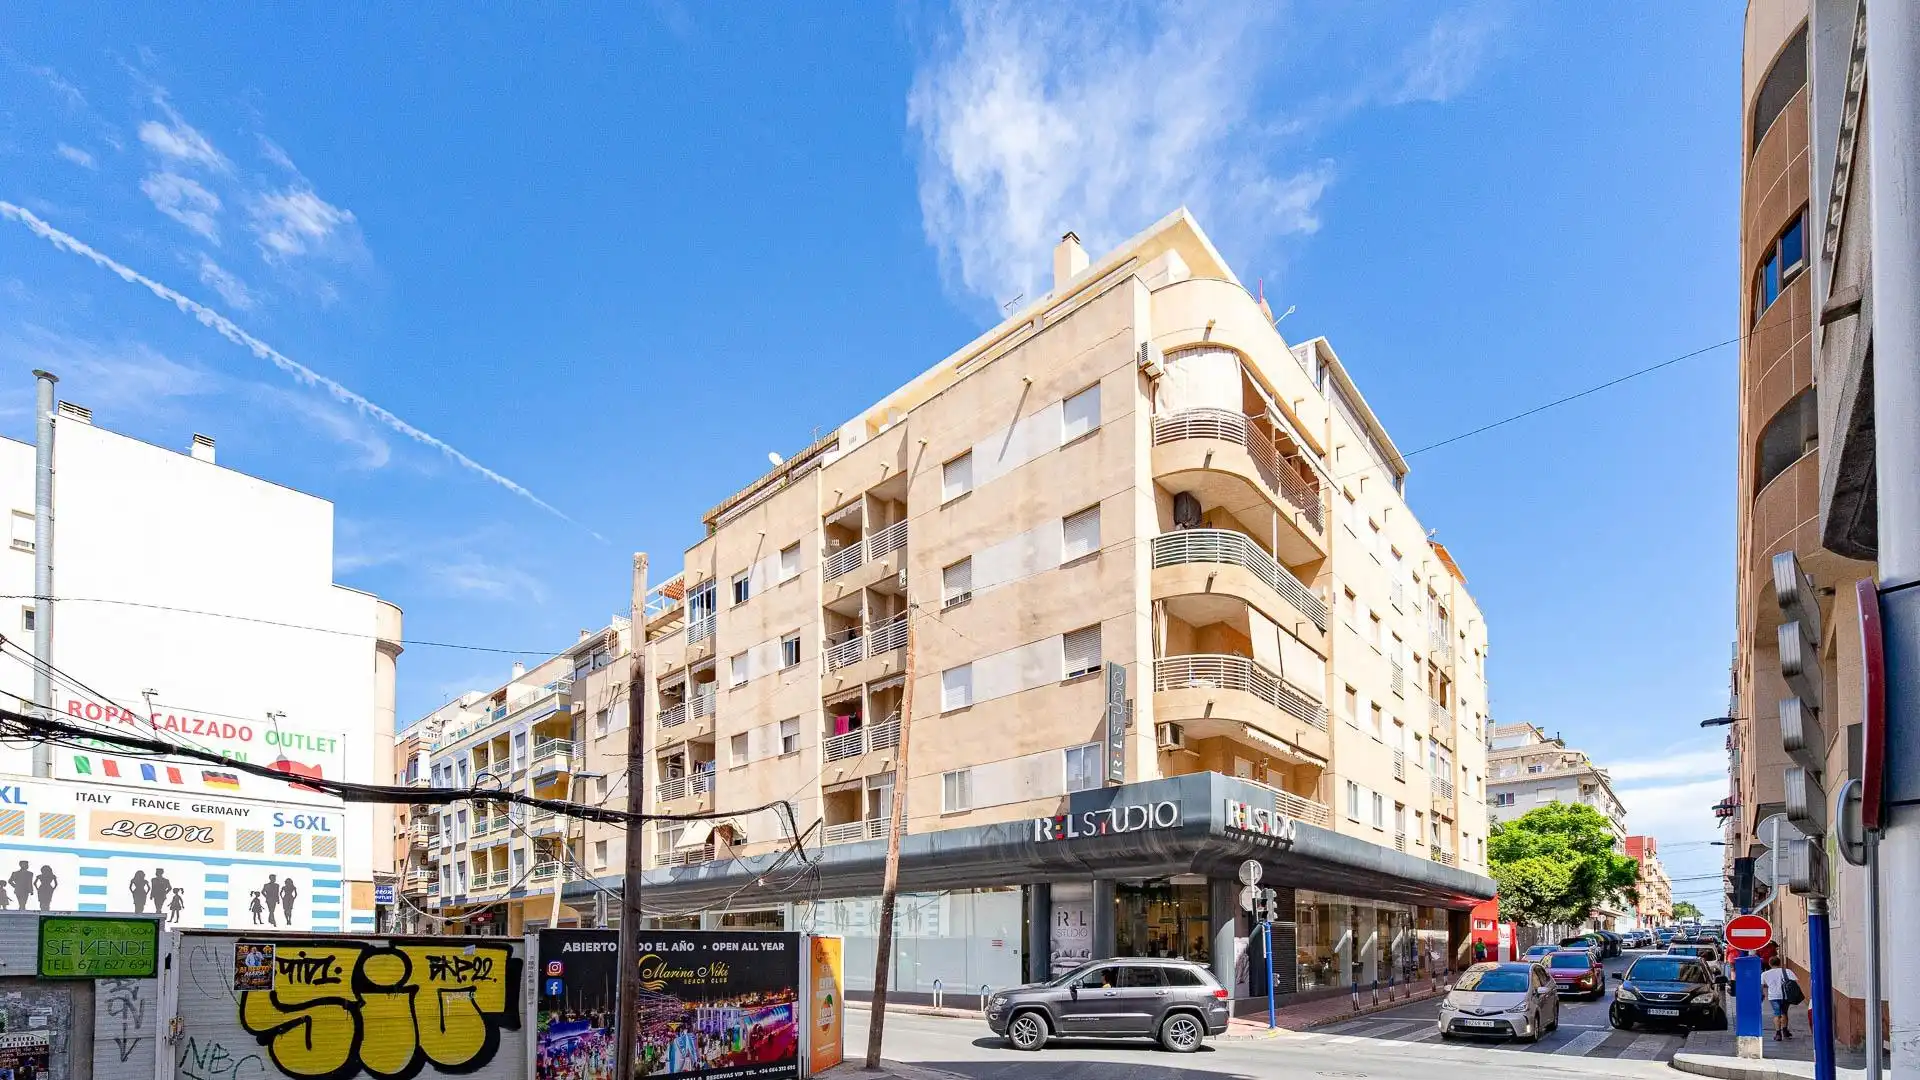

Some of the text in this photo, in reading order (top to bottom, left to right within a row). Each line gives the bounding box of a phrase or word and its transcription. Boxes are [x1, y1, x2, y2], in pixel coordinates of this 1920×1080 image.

[68, 699, 337, 754] ROPA CALZADO OUTLET
[75, 792, 250, 817] ITALY FRANCE GERMANY
[273, 811, 331, 832] S-6XL
[1082, 800, 1178, 837] STUDIO
[46, 939, 153, 956] SE VENDE
[562, 942, 617, 952] ABIERTO
[655, 942, 669, 952] EL
[671, 940, 695, 952] AÑO
[712, 942, 739, 952] OPEN
[741, 942, 760, 951] ALL
[761, 942, 785, 951] YEAR
[78, 960, 100, 970] 677
[104, 960, 125, 970] 627
[642, 960, 730, 979] Marina Niki
